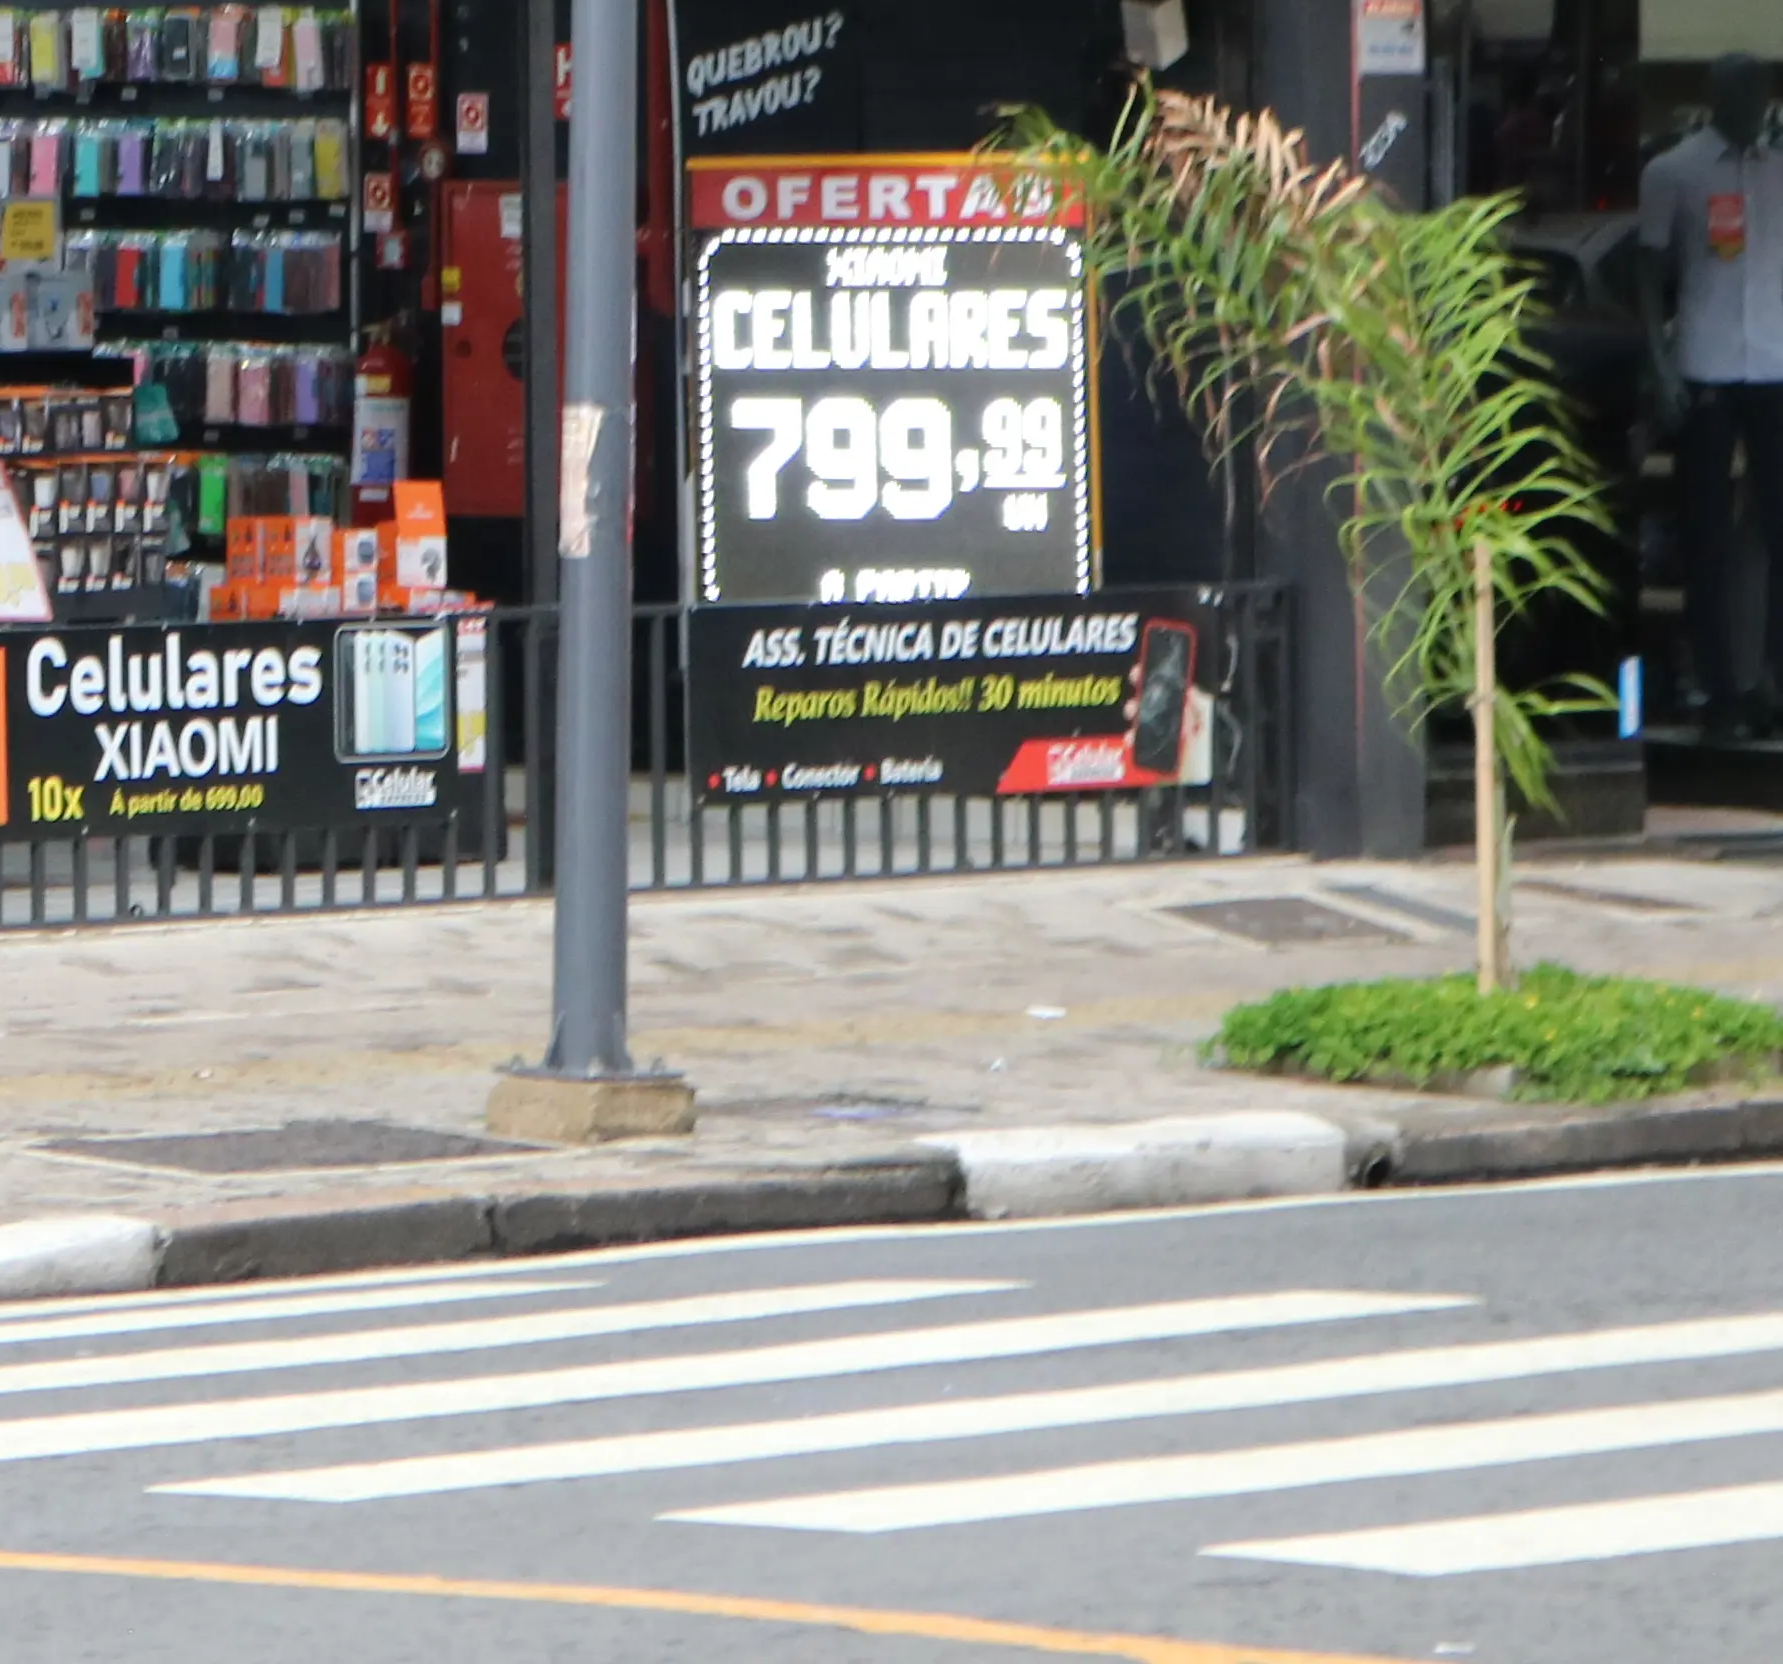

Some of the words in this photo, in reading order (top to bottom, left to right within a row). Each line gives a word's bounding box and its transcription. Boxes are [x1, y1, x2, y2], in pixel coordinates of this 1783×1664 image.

[686, 9, 845, 98] QUEBROU?
[692, 64, 822, 137] TRAVOU?
[713, 290, 1068, 370] CELULARES
[730, 397, 1067, 521] 799,99
[25, 633, 323, 717] Celulares
[742, 630, 807, 669] ASS.
[812, 617, 933, 665] TÉCNICA
[939, 623, 985, 661] DE
[988, 612, 1139, 658] CELULARES
[752, 683, 857, 727] Reparos
[861, 674, 972, 722] Rápidos!!
[976, 676, 1013, 712] 30
[1017, 671, 1121, 710] minutos
[94, 715, 279, 782] XIAOMI
[27, 776, 84, 822] 10x
[127, 786, 178, 817] partir
[180, 785, 203, 813] de
